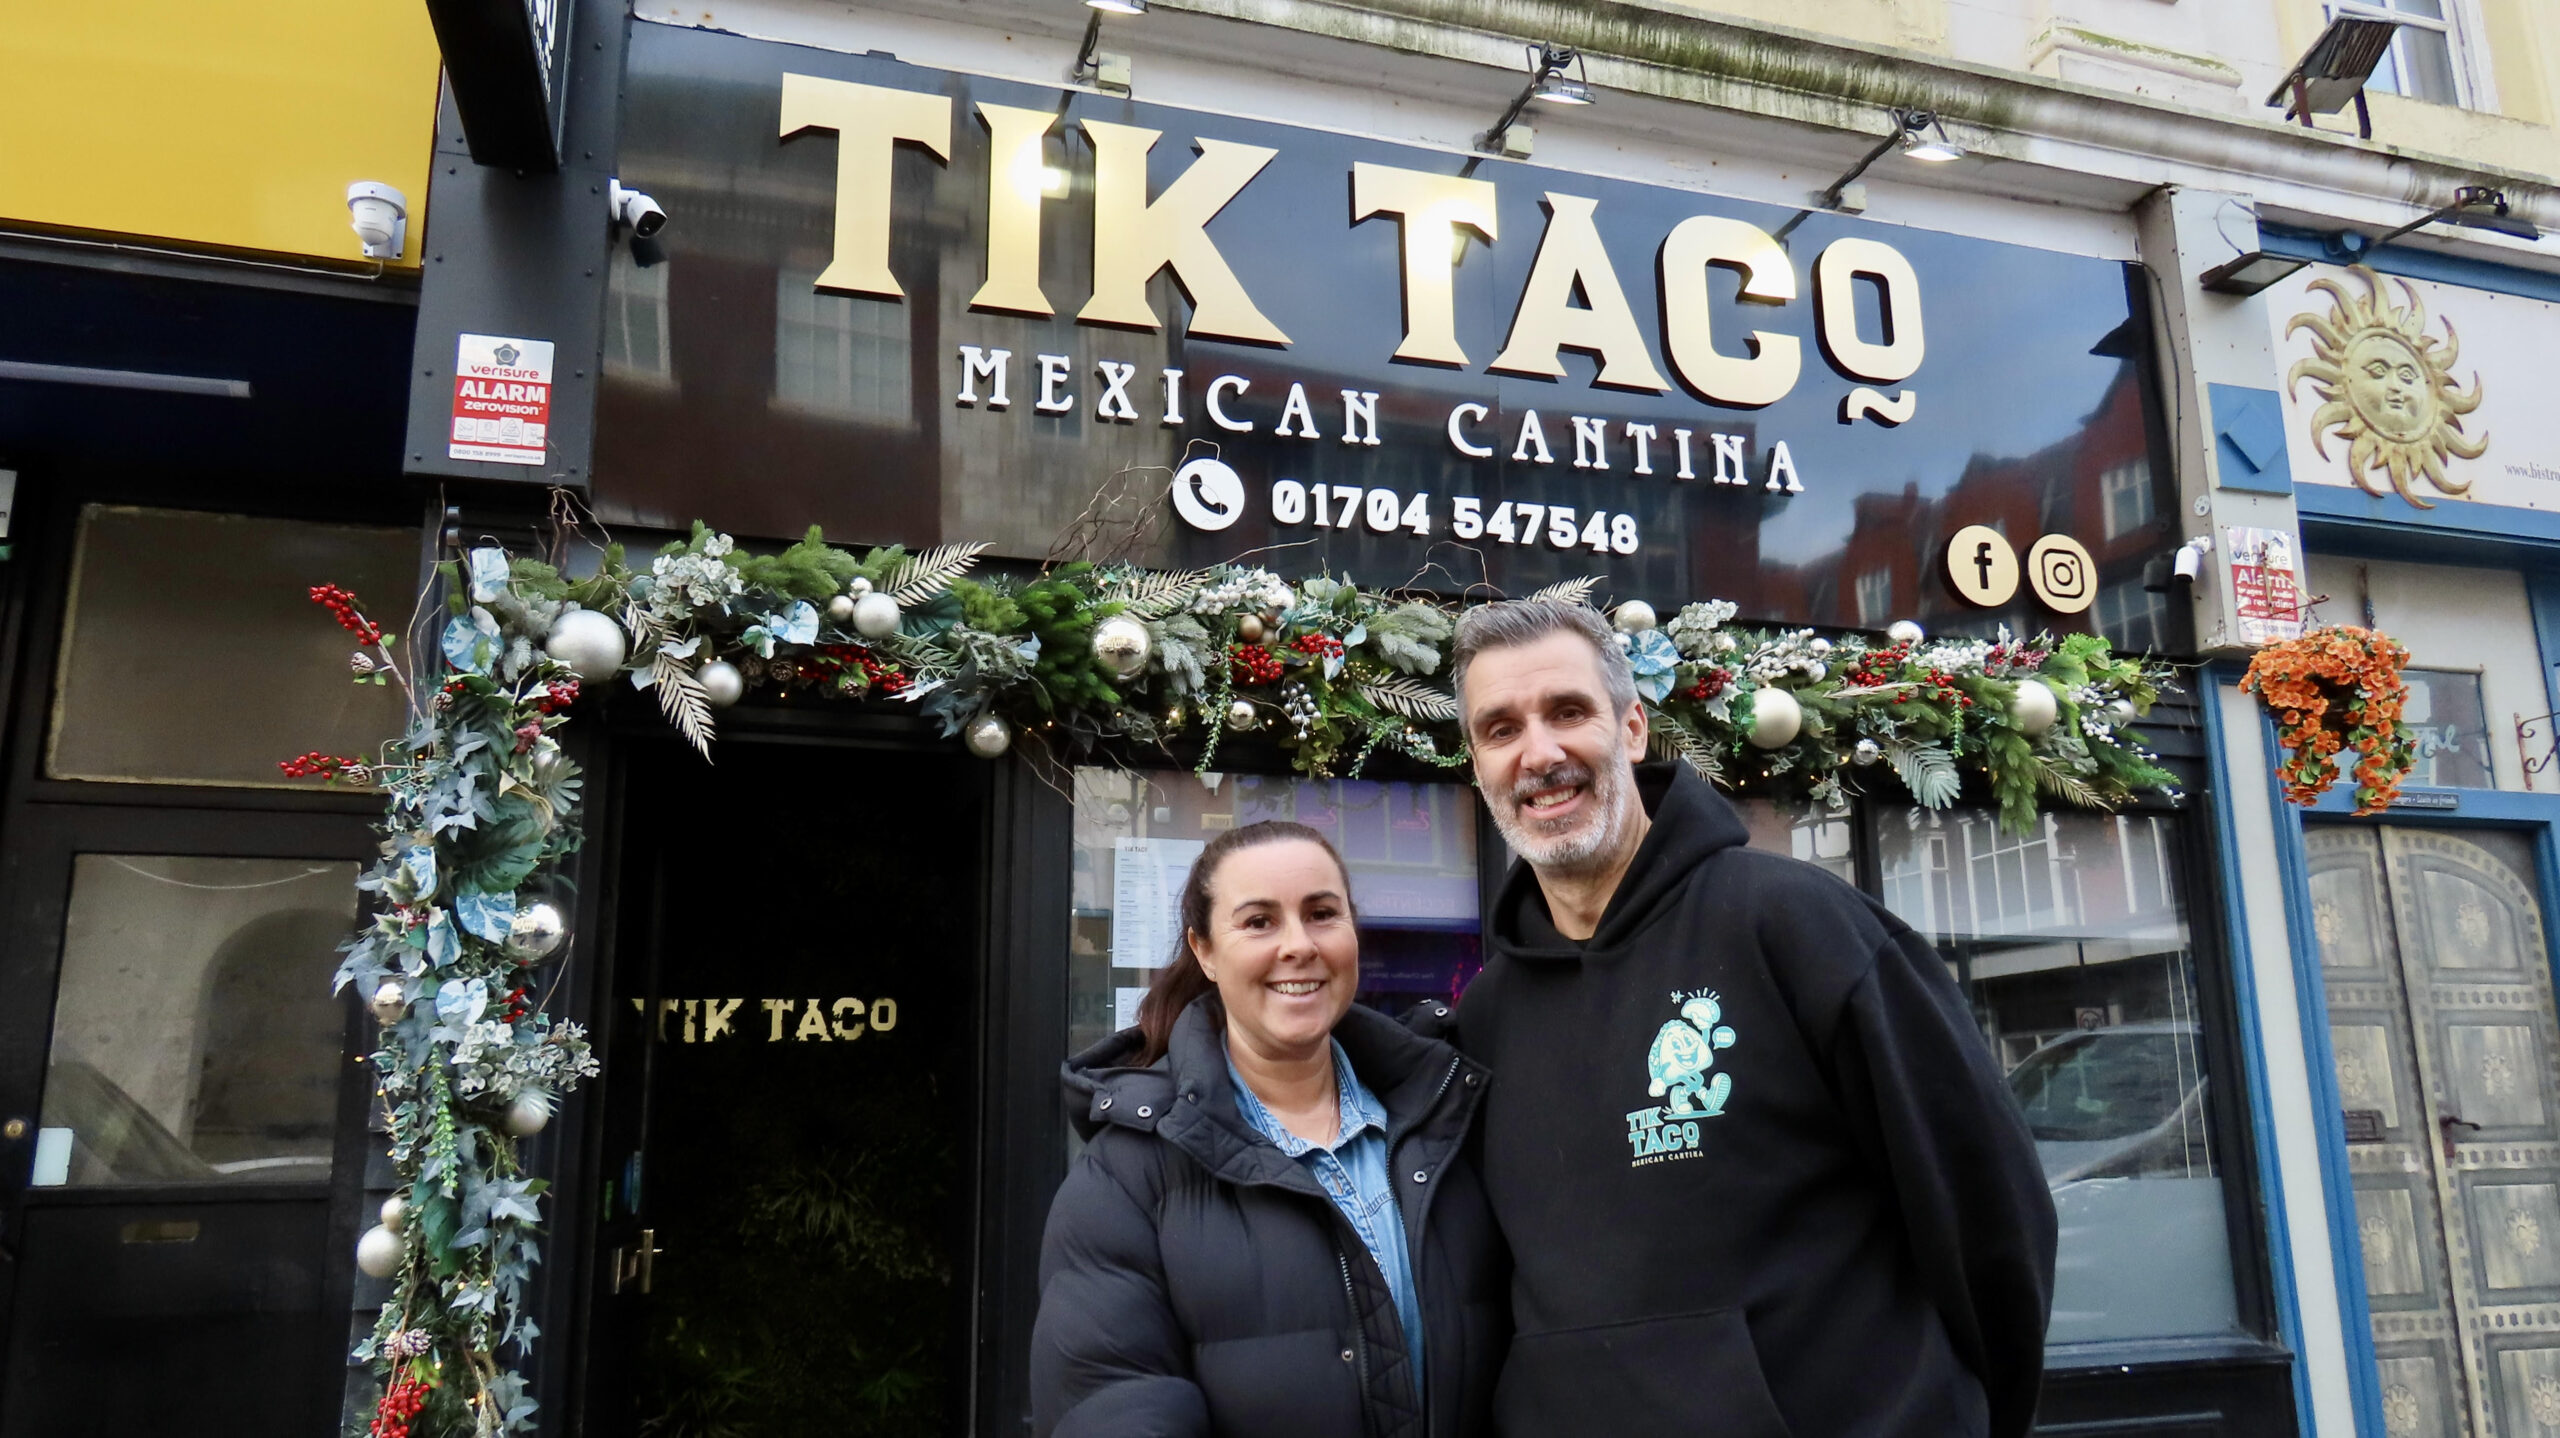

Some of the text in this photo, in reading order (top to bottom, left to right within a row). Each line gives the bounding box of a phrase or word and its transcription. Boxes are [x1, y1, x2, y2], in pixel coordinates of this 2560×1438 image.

[779, 71, 1926, 423] TIK TACO
[471, 365, 540, 379] verisure
[459, 380, 546, 404] ALARM
[957, 345, 1804, 492] MEXICAN CANTINA
[1271, 479, 1639, 555] 01704 547548
[2233, 550, 2288, 564] verure
[760, 996, 898, 1042] TACO
[1626, 1105, 1665, 1132] TIK
[1628, 1120, 1700, 1158] TACO
